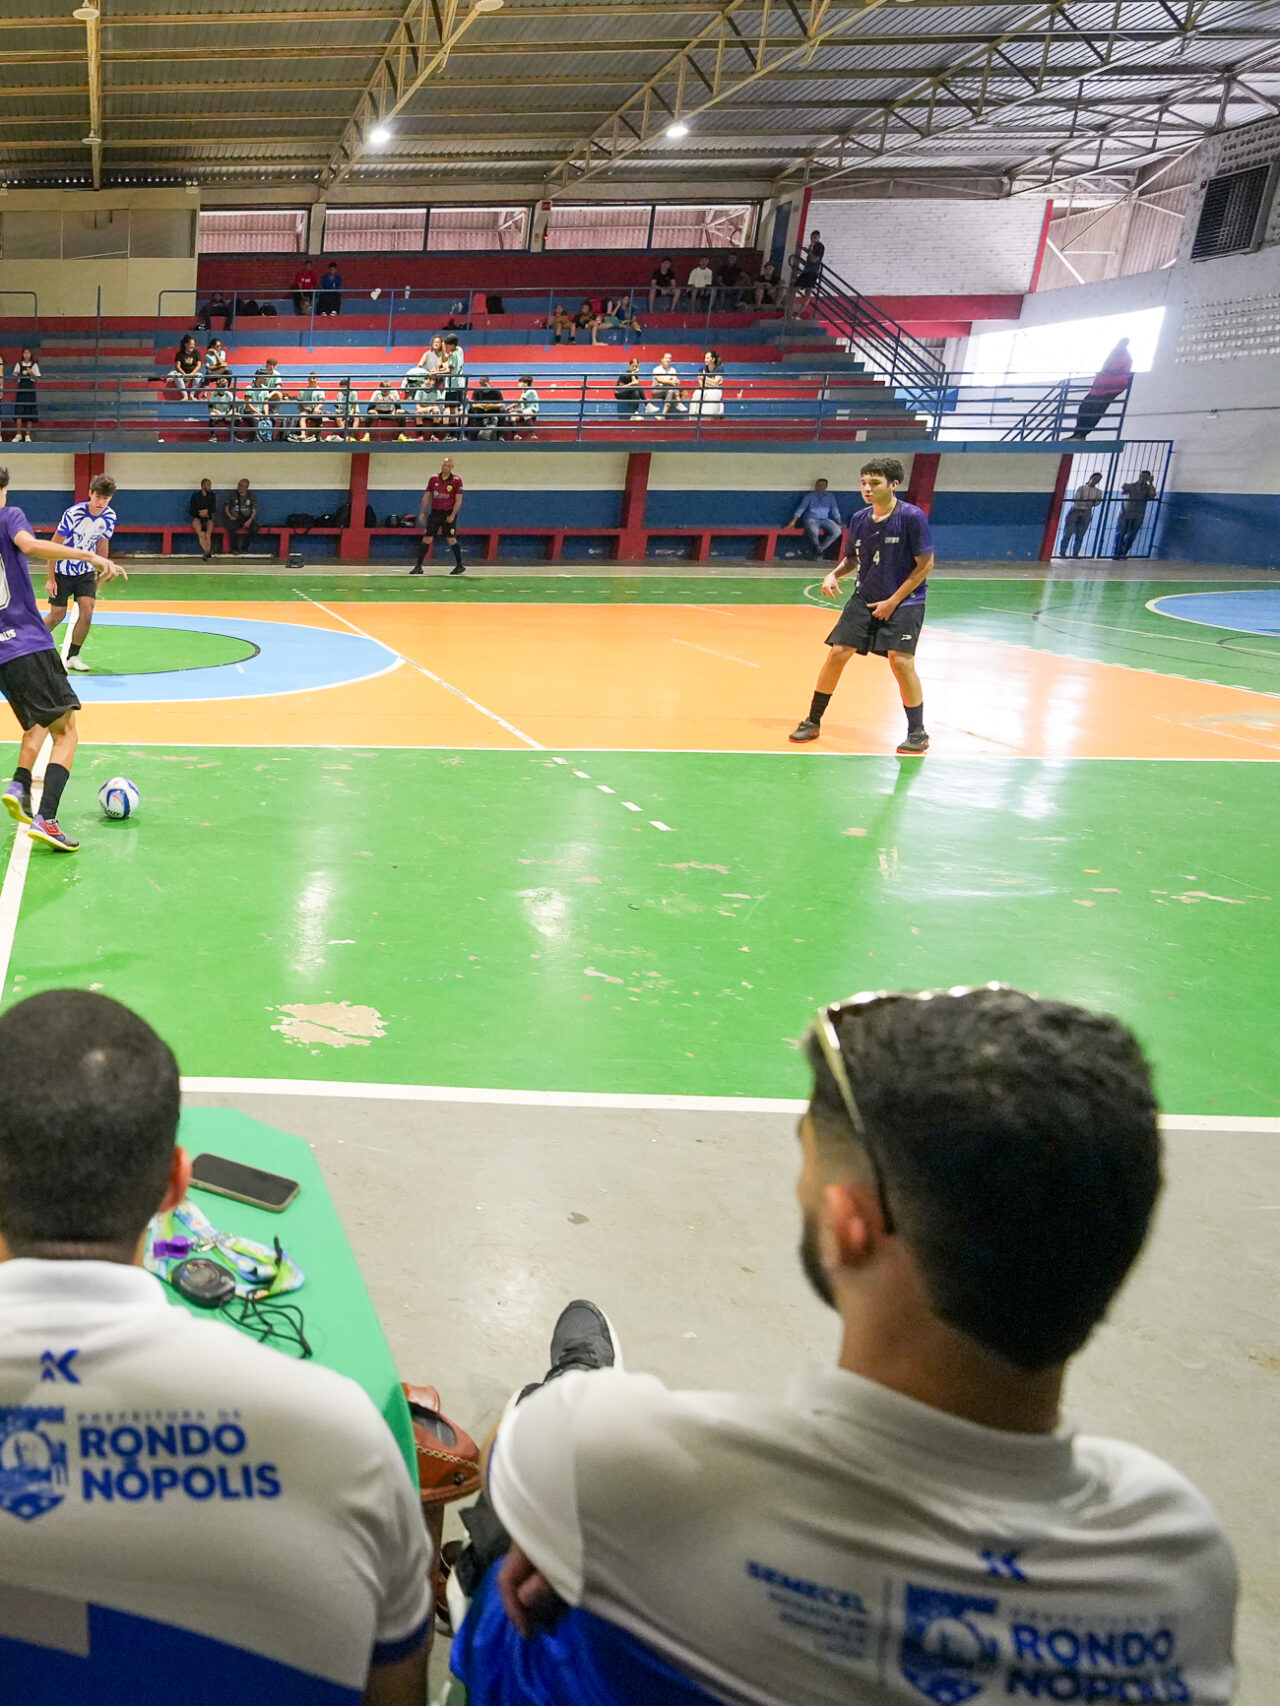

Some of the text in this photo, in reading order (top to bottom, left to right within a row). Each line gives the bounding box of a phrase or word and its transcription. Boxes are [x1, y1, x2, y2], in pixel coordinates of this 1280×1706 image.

[872, 550, 880, 566] 4
[79, 1424, 247, 1458] RONDO
[1011, 1622, 1175, 1668] RONDO
